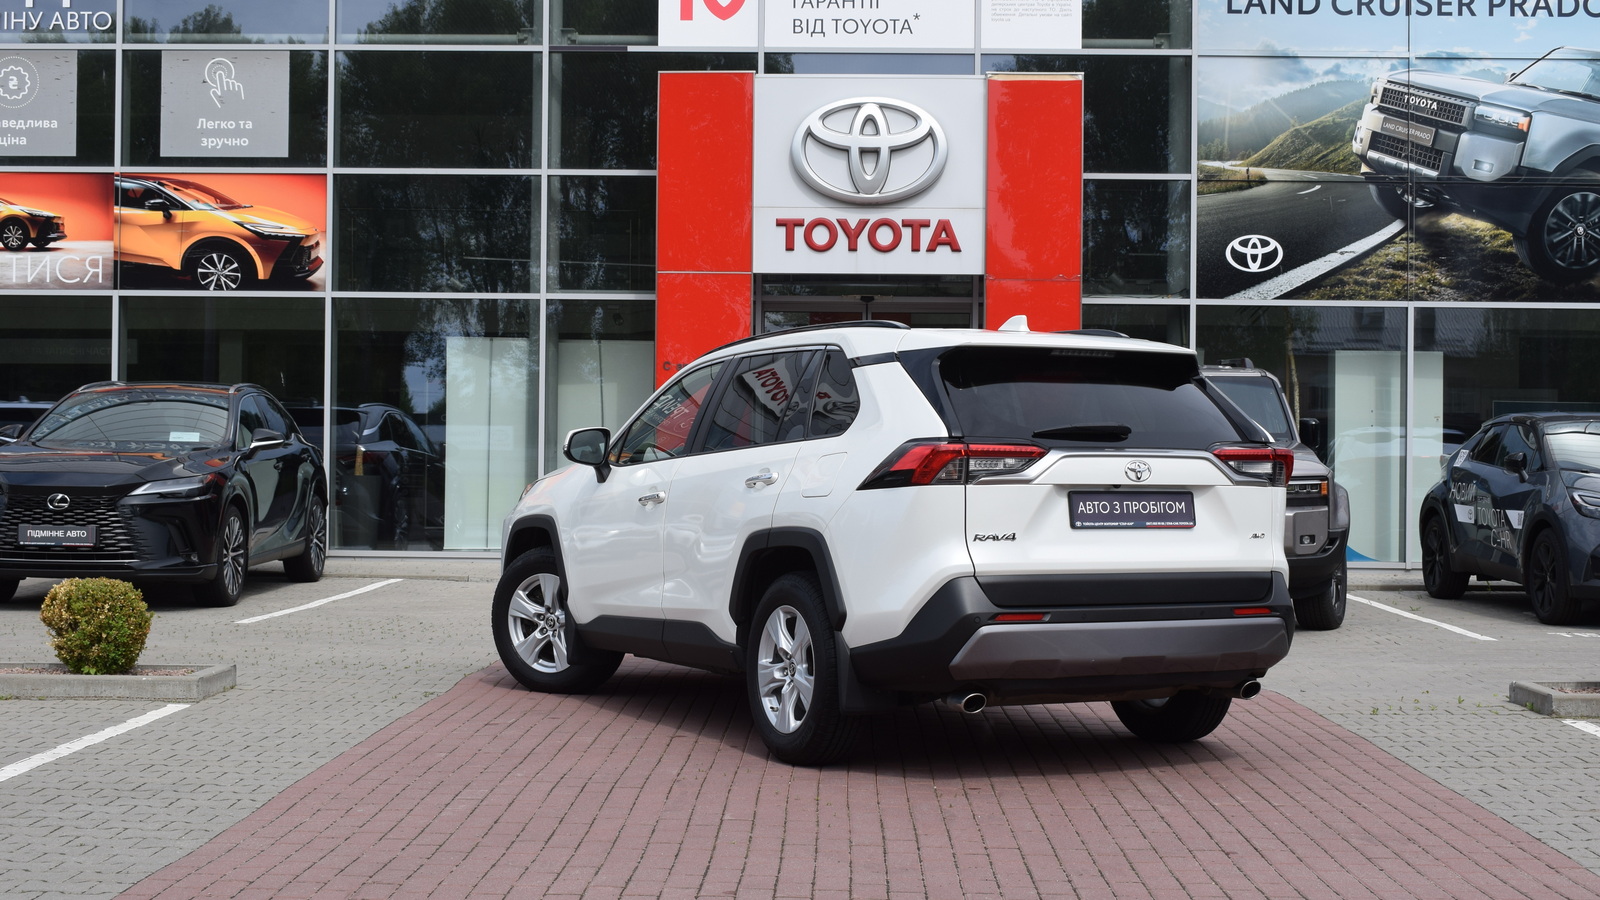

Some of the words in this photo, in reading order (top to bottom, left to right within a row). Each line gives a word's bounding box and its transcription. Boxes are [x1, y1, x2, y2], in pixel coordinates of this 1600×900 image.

[1227, 0, 1321, 15] LAND
[1331, 0, 1477, 17] CRUISER
[49, 11, 112, 30] АВТО
[793, 19, 825, 37] ВІД
[1404, 95, 1438, 111] TOYOTA
[0, 119, 58, 130] ведлива
[196, 118, 236, 129] Легко
[239, 121, 253, 129] та
[1383, 122, 1395, 130] LAND
[1395, 125, 1415, 135] CRUISER
[1415, 129, 1431, 140] PRADO
[200, 138, 249, 148] зручно
[775, 217, 962, 252] TOYOTA
[5, 255, 103, 284] ТИСЯ
[1449, 480, 1476, 501] НОВИЙ
[1078, 501, 1110, 514] АВТО
[1113, 501, 1121, 514] З
[1123, 501, 1186, 514] ПРОБІГОМ
[1477, 506, 1507, 528] TOYOTA
[27, 530, 65, 538] ПІДМІННЕ
[66, 530, 87, 538] АВТО
[973, 532, 1017, 542] RAV4
[1490, 528, 1513, 549] C-HR
